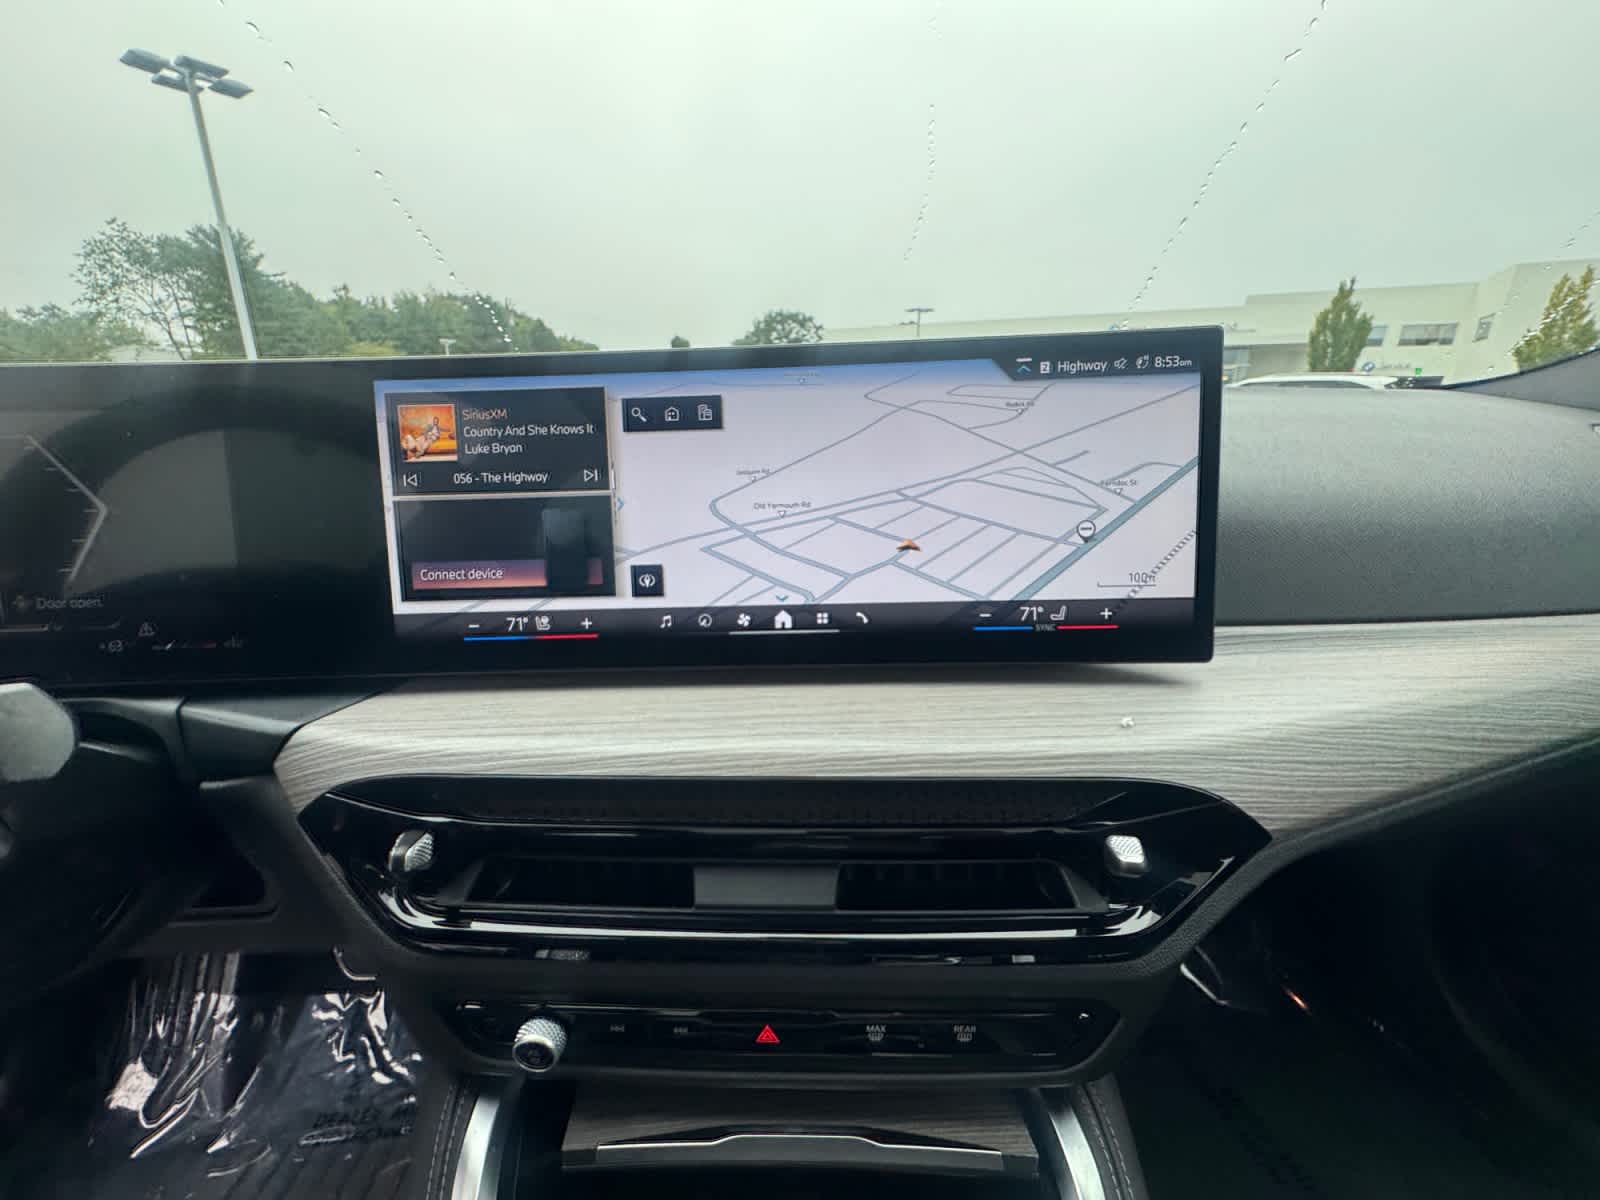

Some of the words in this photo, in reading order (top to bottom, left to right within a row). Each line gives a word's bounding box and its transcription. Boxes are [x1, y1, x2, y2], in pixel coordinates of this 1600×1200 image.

[1057, 360, 1108, 375] Highway
[1154, 355, 1193, 368] 8:53am
[462, 408, 508, 421] SiriusXM
[463, 426, 503, 439] Country
[504, 425, 525, 437] And
[527, 424, 548, 436] She
[550, 423, 584, 435] Knows
[586, 423, 594, 434] It
[464, 443, 490, 455] Luke
[492, 442, 523, 456] Bryan
[453, 473, 472, 485] 056
[480, 471, 501, 483] The
[503, 470, 549, 485] Highway
[420, 568, 466, 580] Connect
[469, 567, 504, 580] device
[36, 598, 67, 609] Door
[1035, 624, 1056, 632] SYNC
[865, 1024, 887, 1033] MAX
[953, 1024, 977, 1033] REAR
